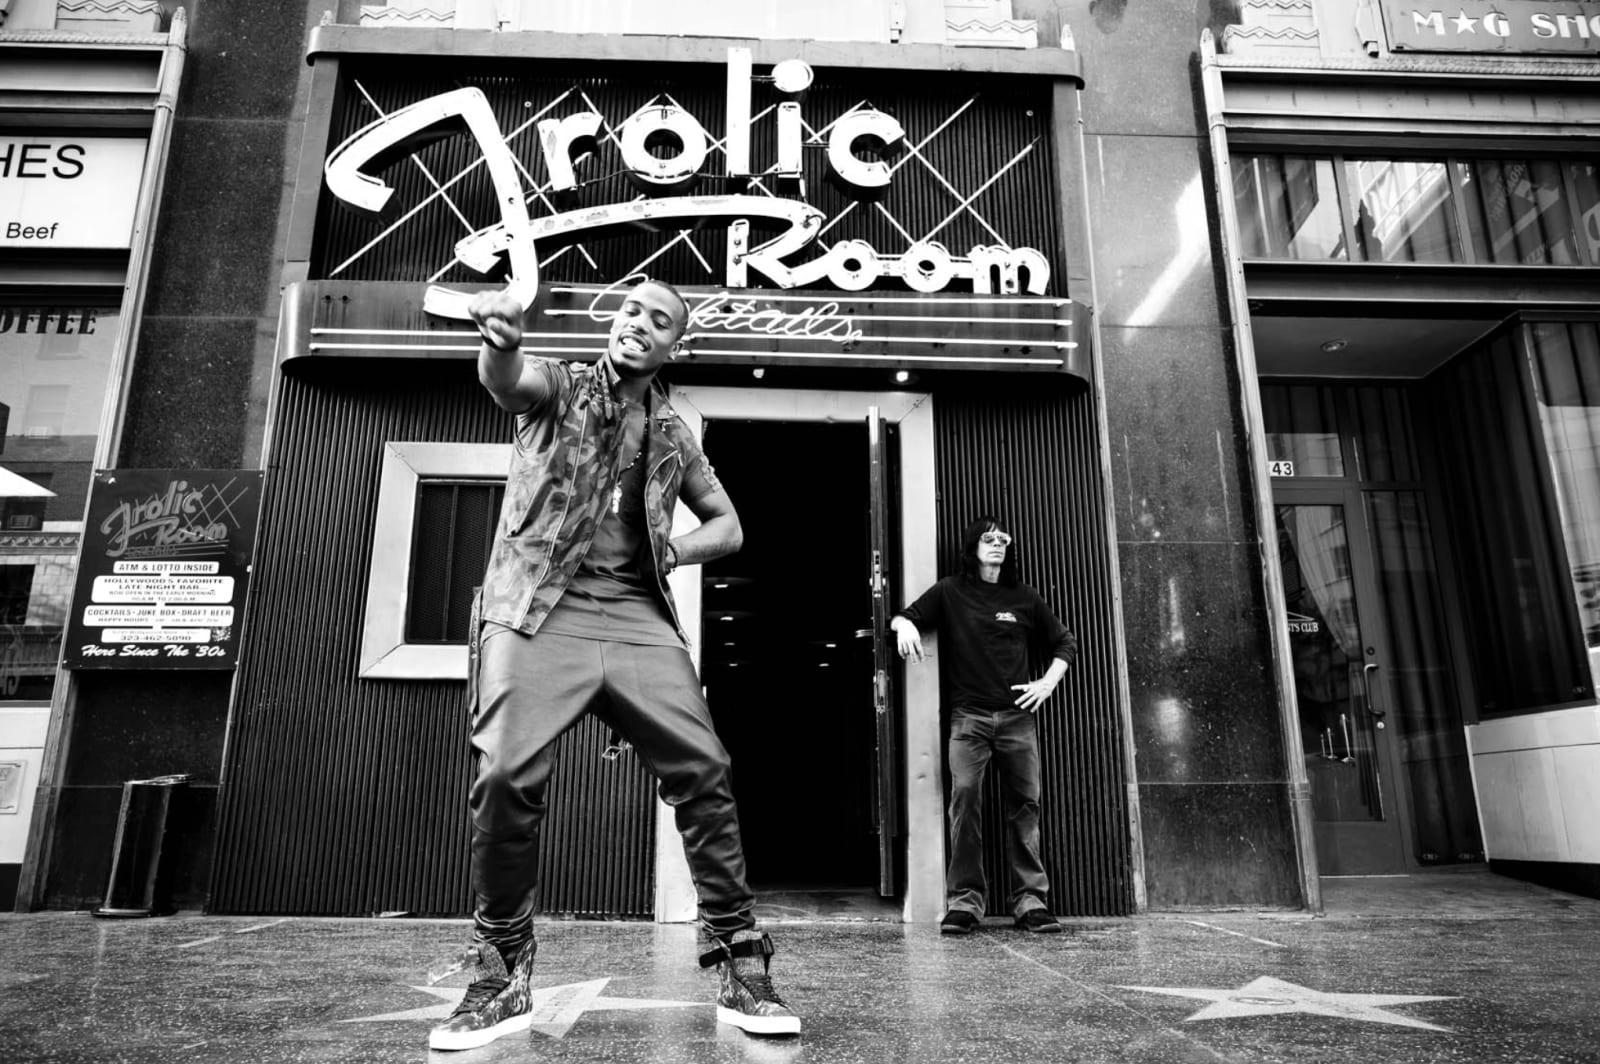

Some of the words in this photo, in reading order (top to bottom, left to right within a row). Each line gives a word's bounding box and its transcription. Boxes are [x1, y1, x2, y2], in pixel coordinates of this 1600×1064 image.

[325, 47, 905, 320] Frolic
[6, 222, 59, 240] Beef
[455, 194, 1050, 296] Room
[589, 272, 864, 344] Cktails
[101, 480, 203, 557] Frolic
[81, 645, 116, 657] Here
[119, 645, 159, 657] Since
[163, 645, 190, 657] The
[1300, 622, 1319, 632] CLUB
